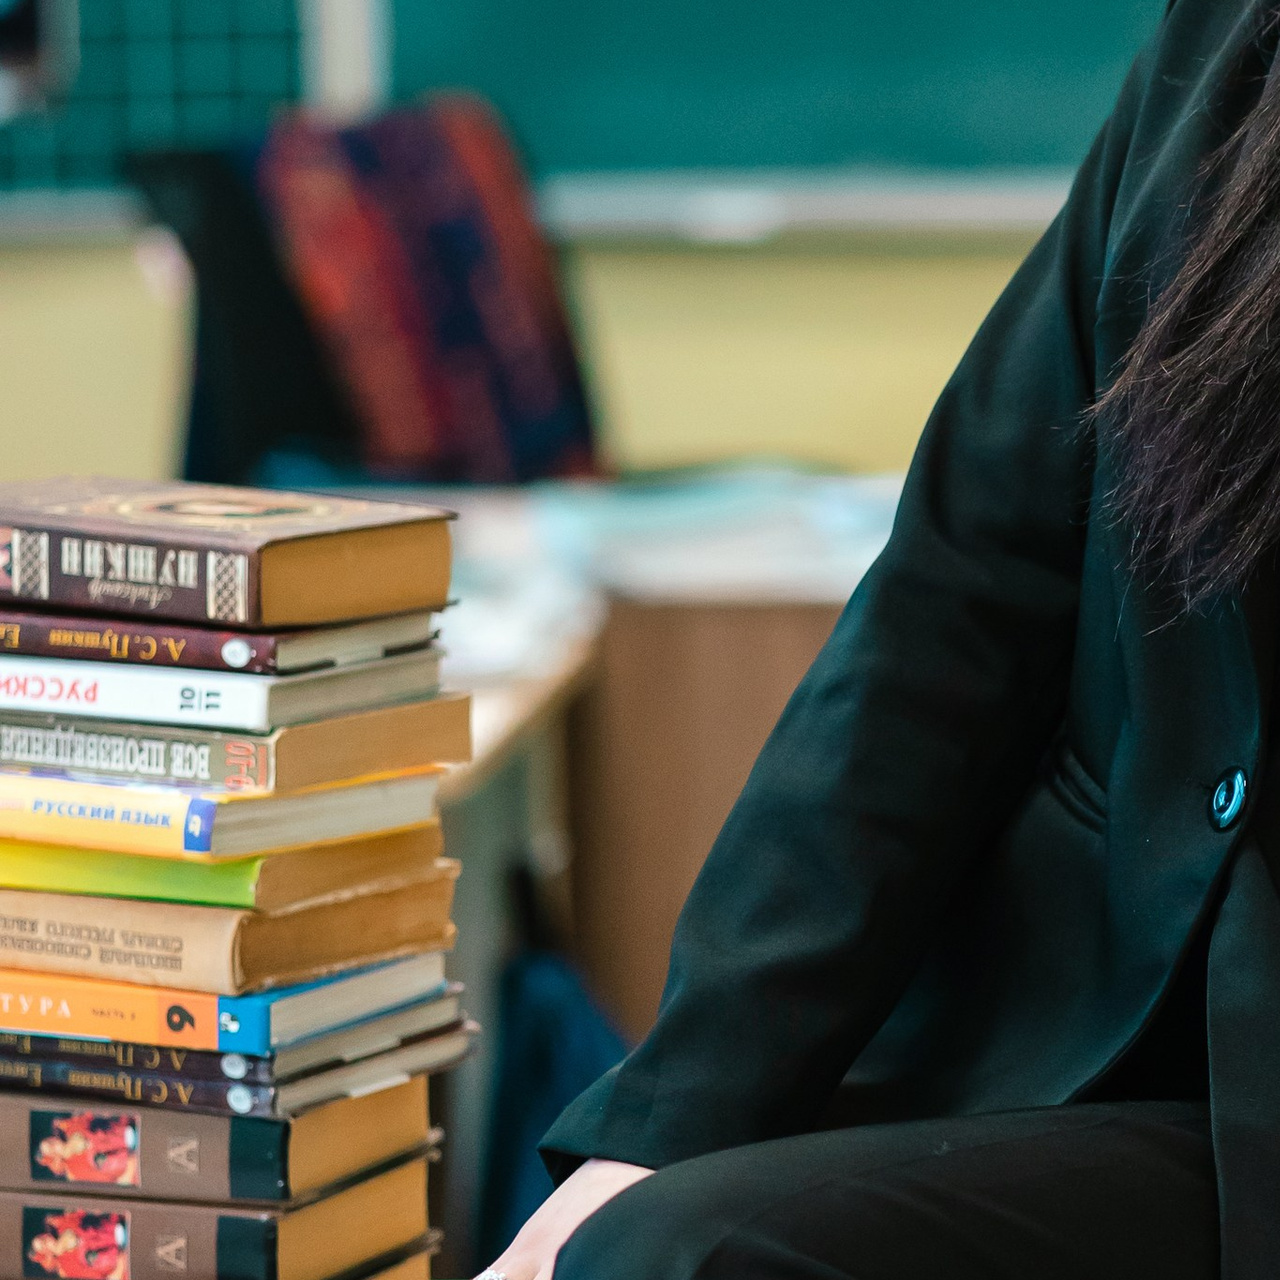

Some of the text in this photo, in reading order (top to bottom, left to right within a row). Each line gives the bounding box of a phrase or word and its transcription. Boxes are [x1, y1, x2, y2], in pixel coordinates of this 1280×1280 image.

[60, 537, 199, 589] ПУШКИН
[48, 628, 130, 659] Пушкин
[179, 687, 196, 711] 10
[205, 687, 222, 711] 11
[170, 741, 211, 780] ВСЕ
[32, 798, 116, 821] РУССКИЙ
[120, 810, 172, 828] ЯЗЫК
